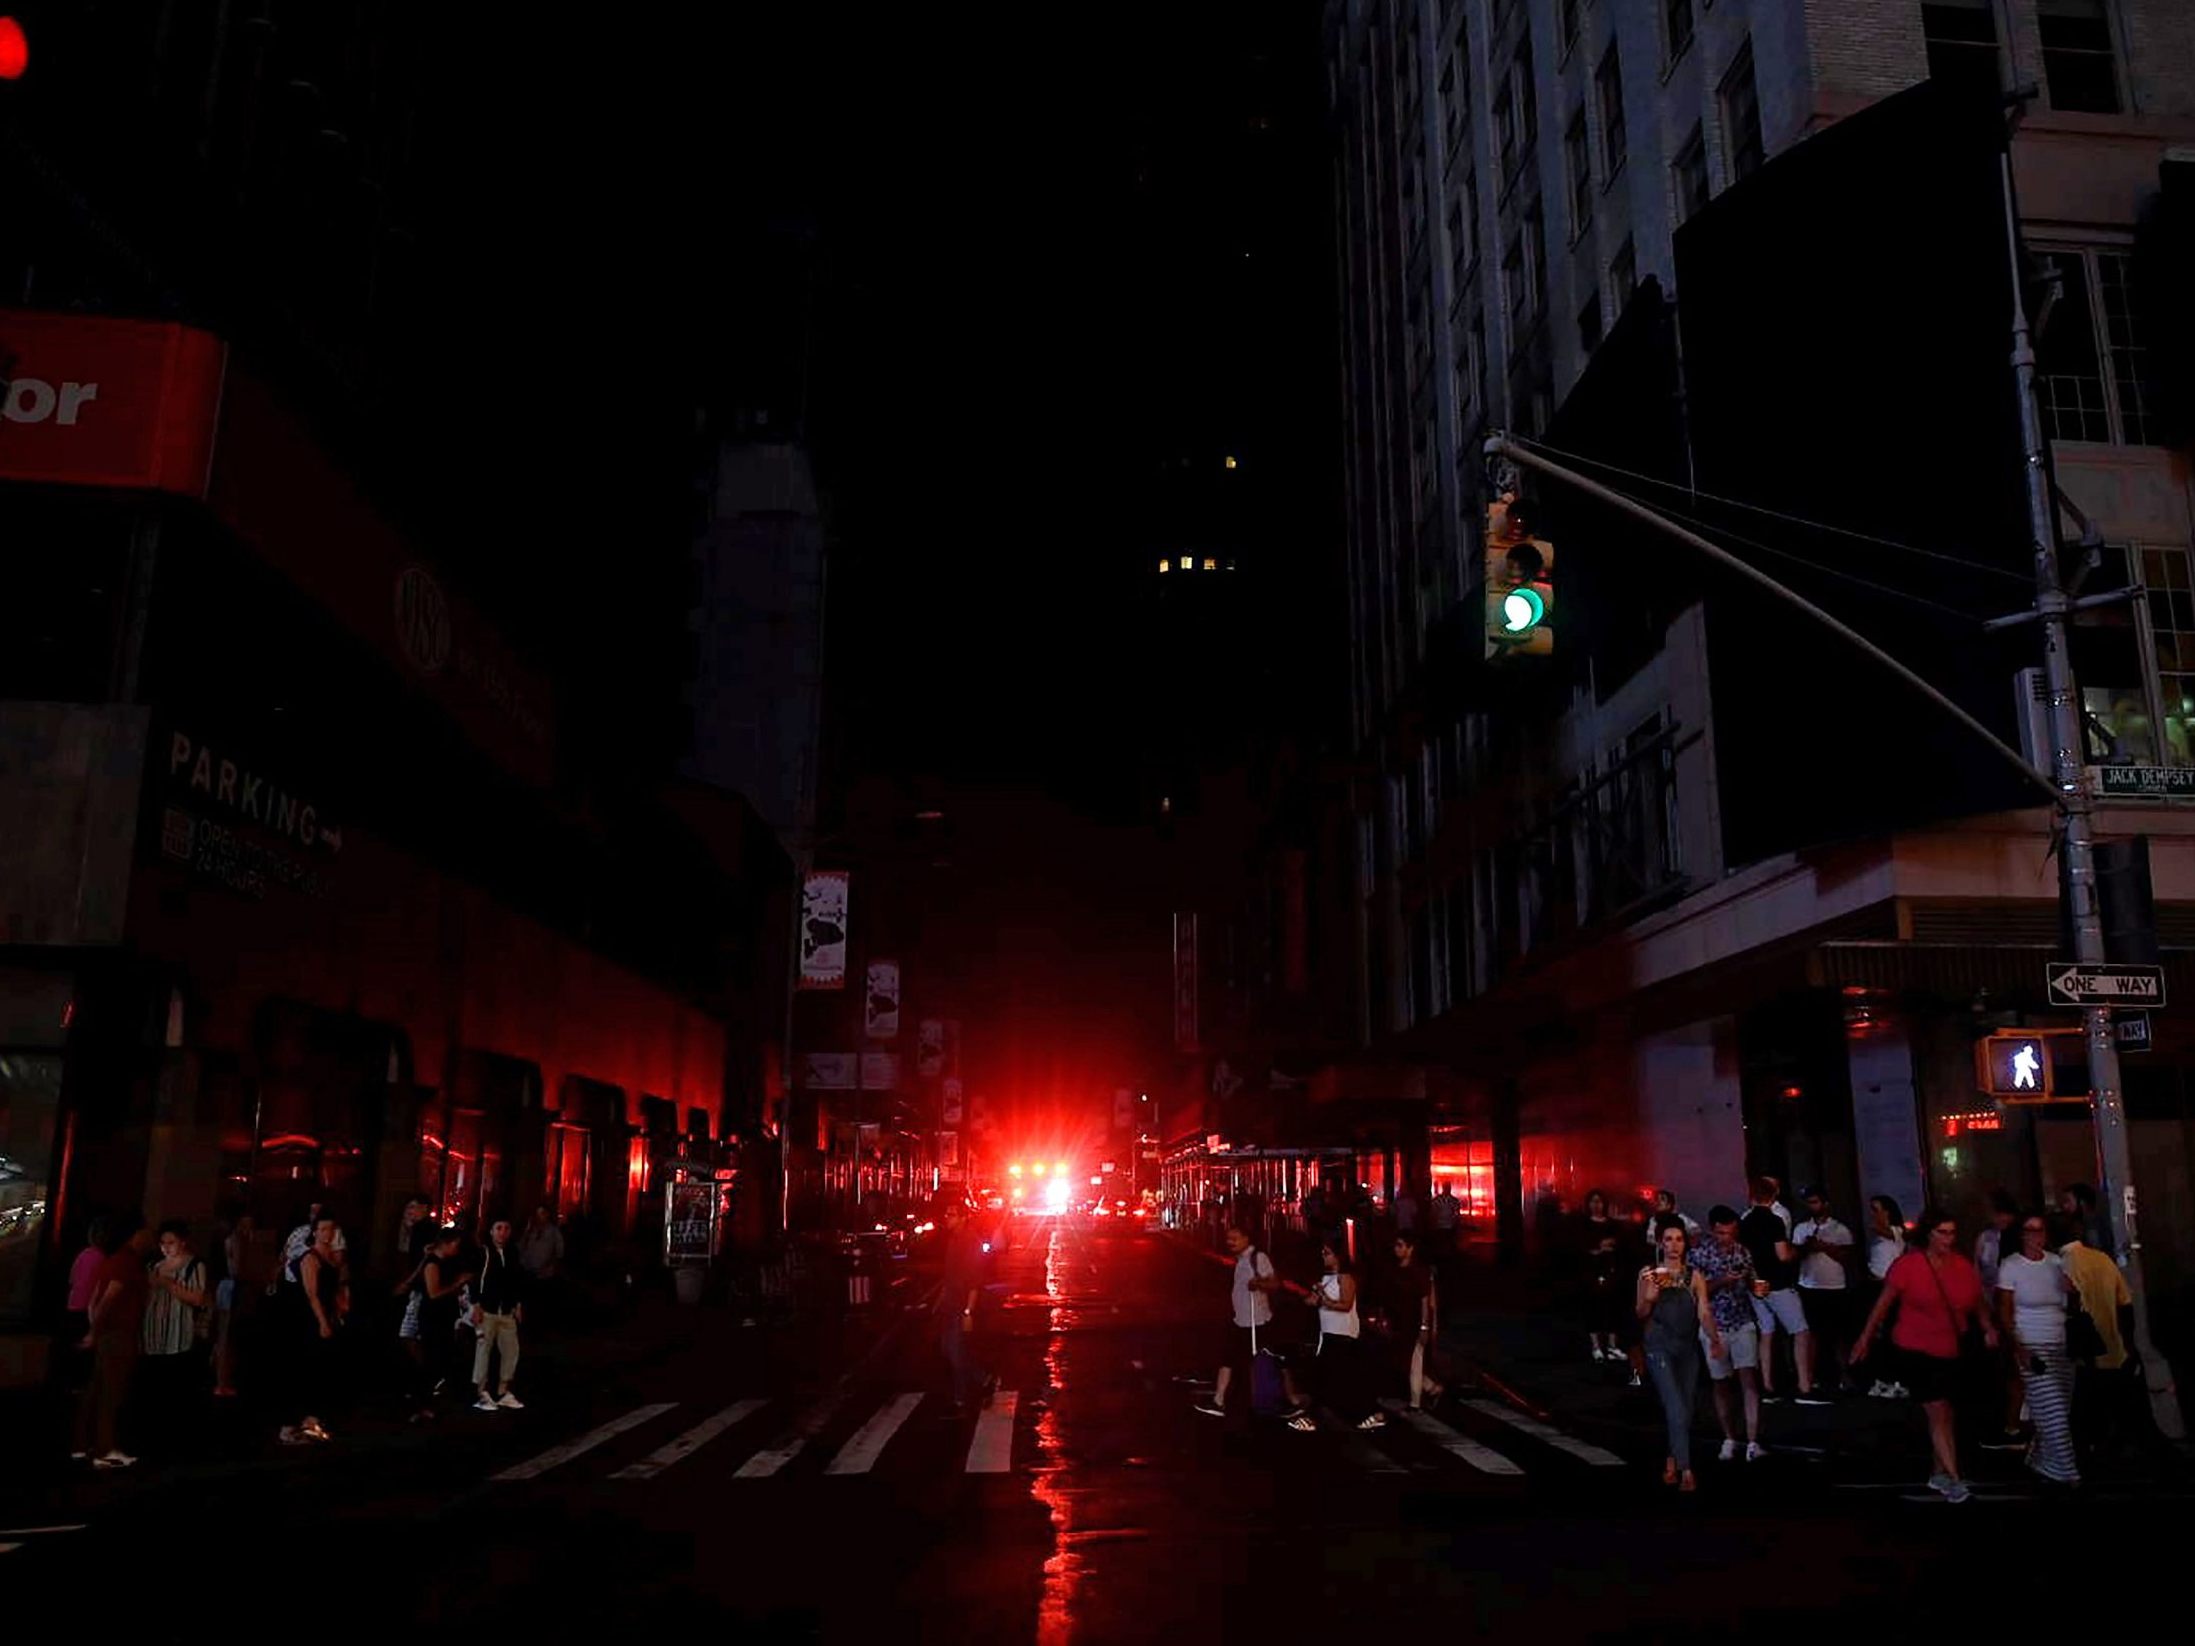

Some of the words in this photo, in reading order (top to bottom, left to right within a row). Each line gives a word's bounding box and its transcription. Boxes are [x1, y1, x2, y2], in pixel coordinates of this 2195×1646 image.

[2107, 769, 2137, 784] JACK
[170, 730, 317, 846] PARKING
[2063, 977, 2097, 993] ONE
[2116, 977, 2152, 993] WAY
